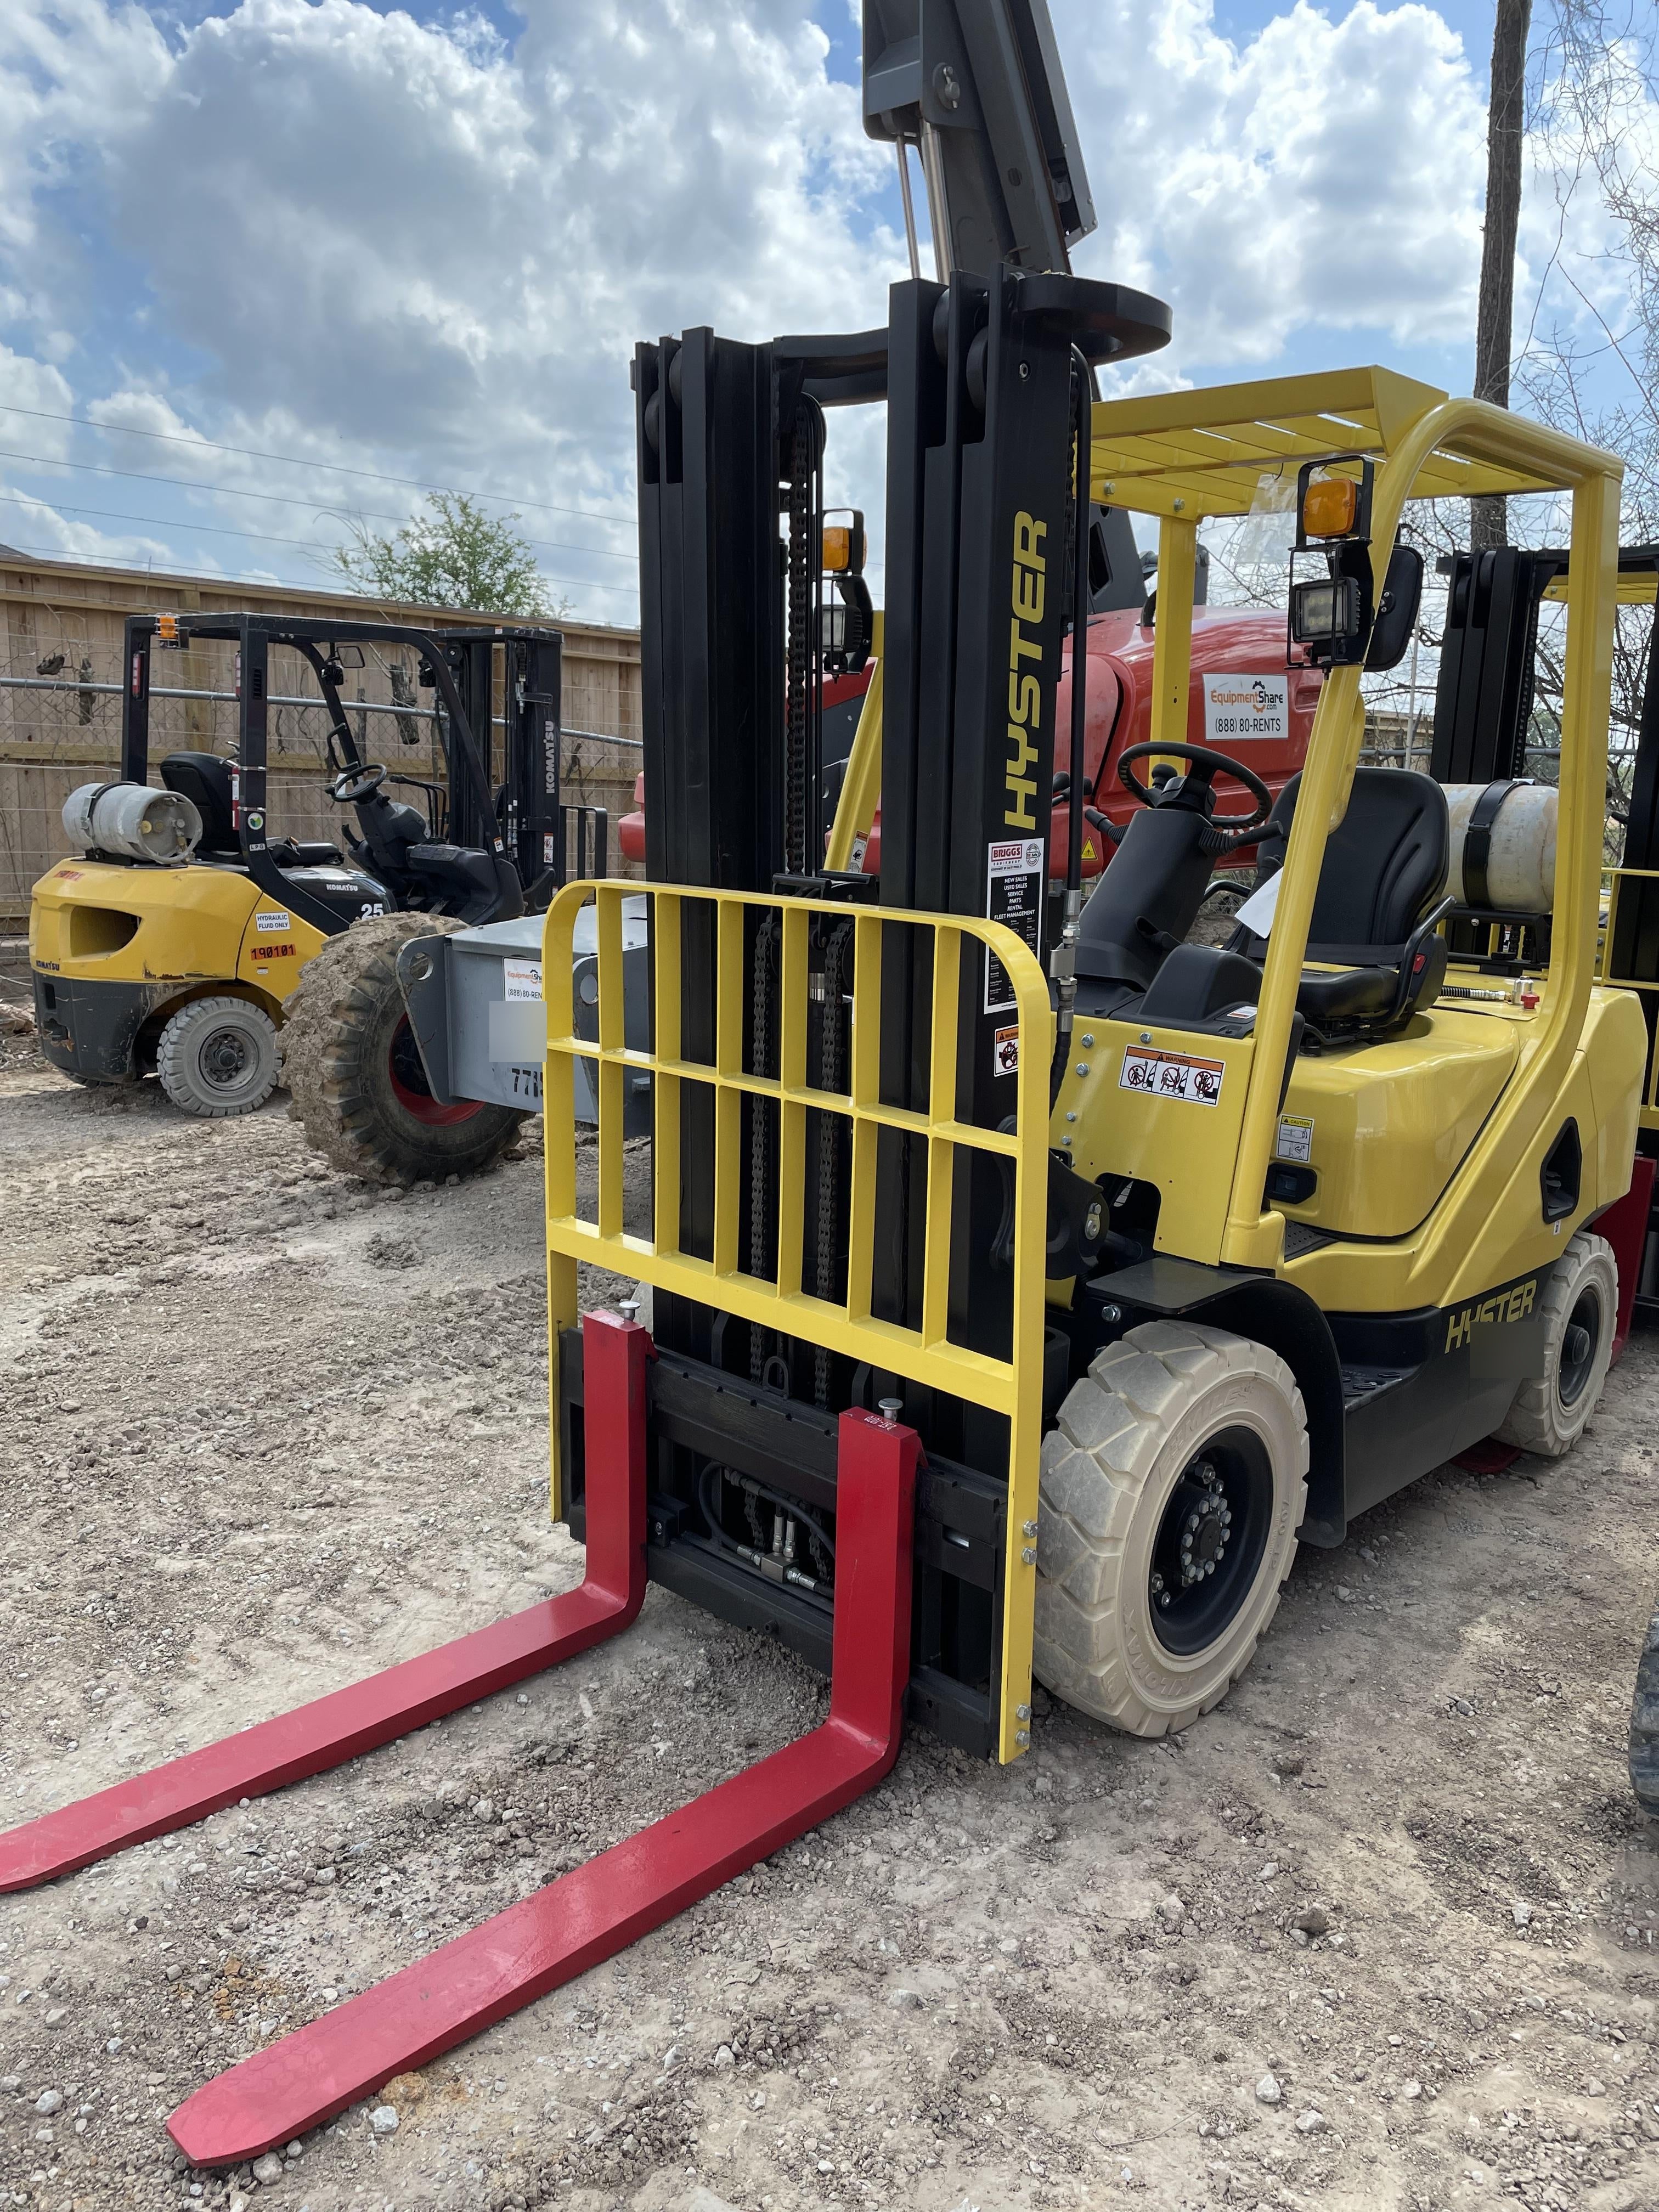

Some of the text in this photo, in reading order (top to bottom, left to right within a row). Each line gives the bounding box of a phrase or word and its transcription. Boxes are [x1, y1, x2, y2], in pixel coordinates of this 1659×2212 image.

[1005, 510, 1047, 830] HYSTER
[1211, 690, 1283, 706] EquipmentShare
[1215, 717, 1281, 733] (888) 80-RENTS
[543, 720, 555, 793] KOMATSU
[994, 847, 1020, 859] BRIGGS
[326, 883, 358, 891] KOMATSU
[361, 903, 383, 921] 25
[1007, 909, 1035, 918] MANAGEMENT
[251, 944, 294, 960] 190101
[508, 988, 522, 998] (888)
[1165, 1056, 1190, 1065] WARNING
[1444, 1279, 1537, 1355] HYSTER
